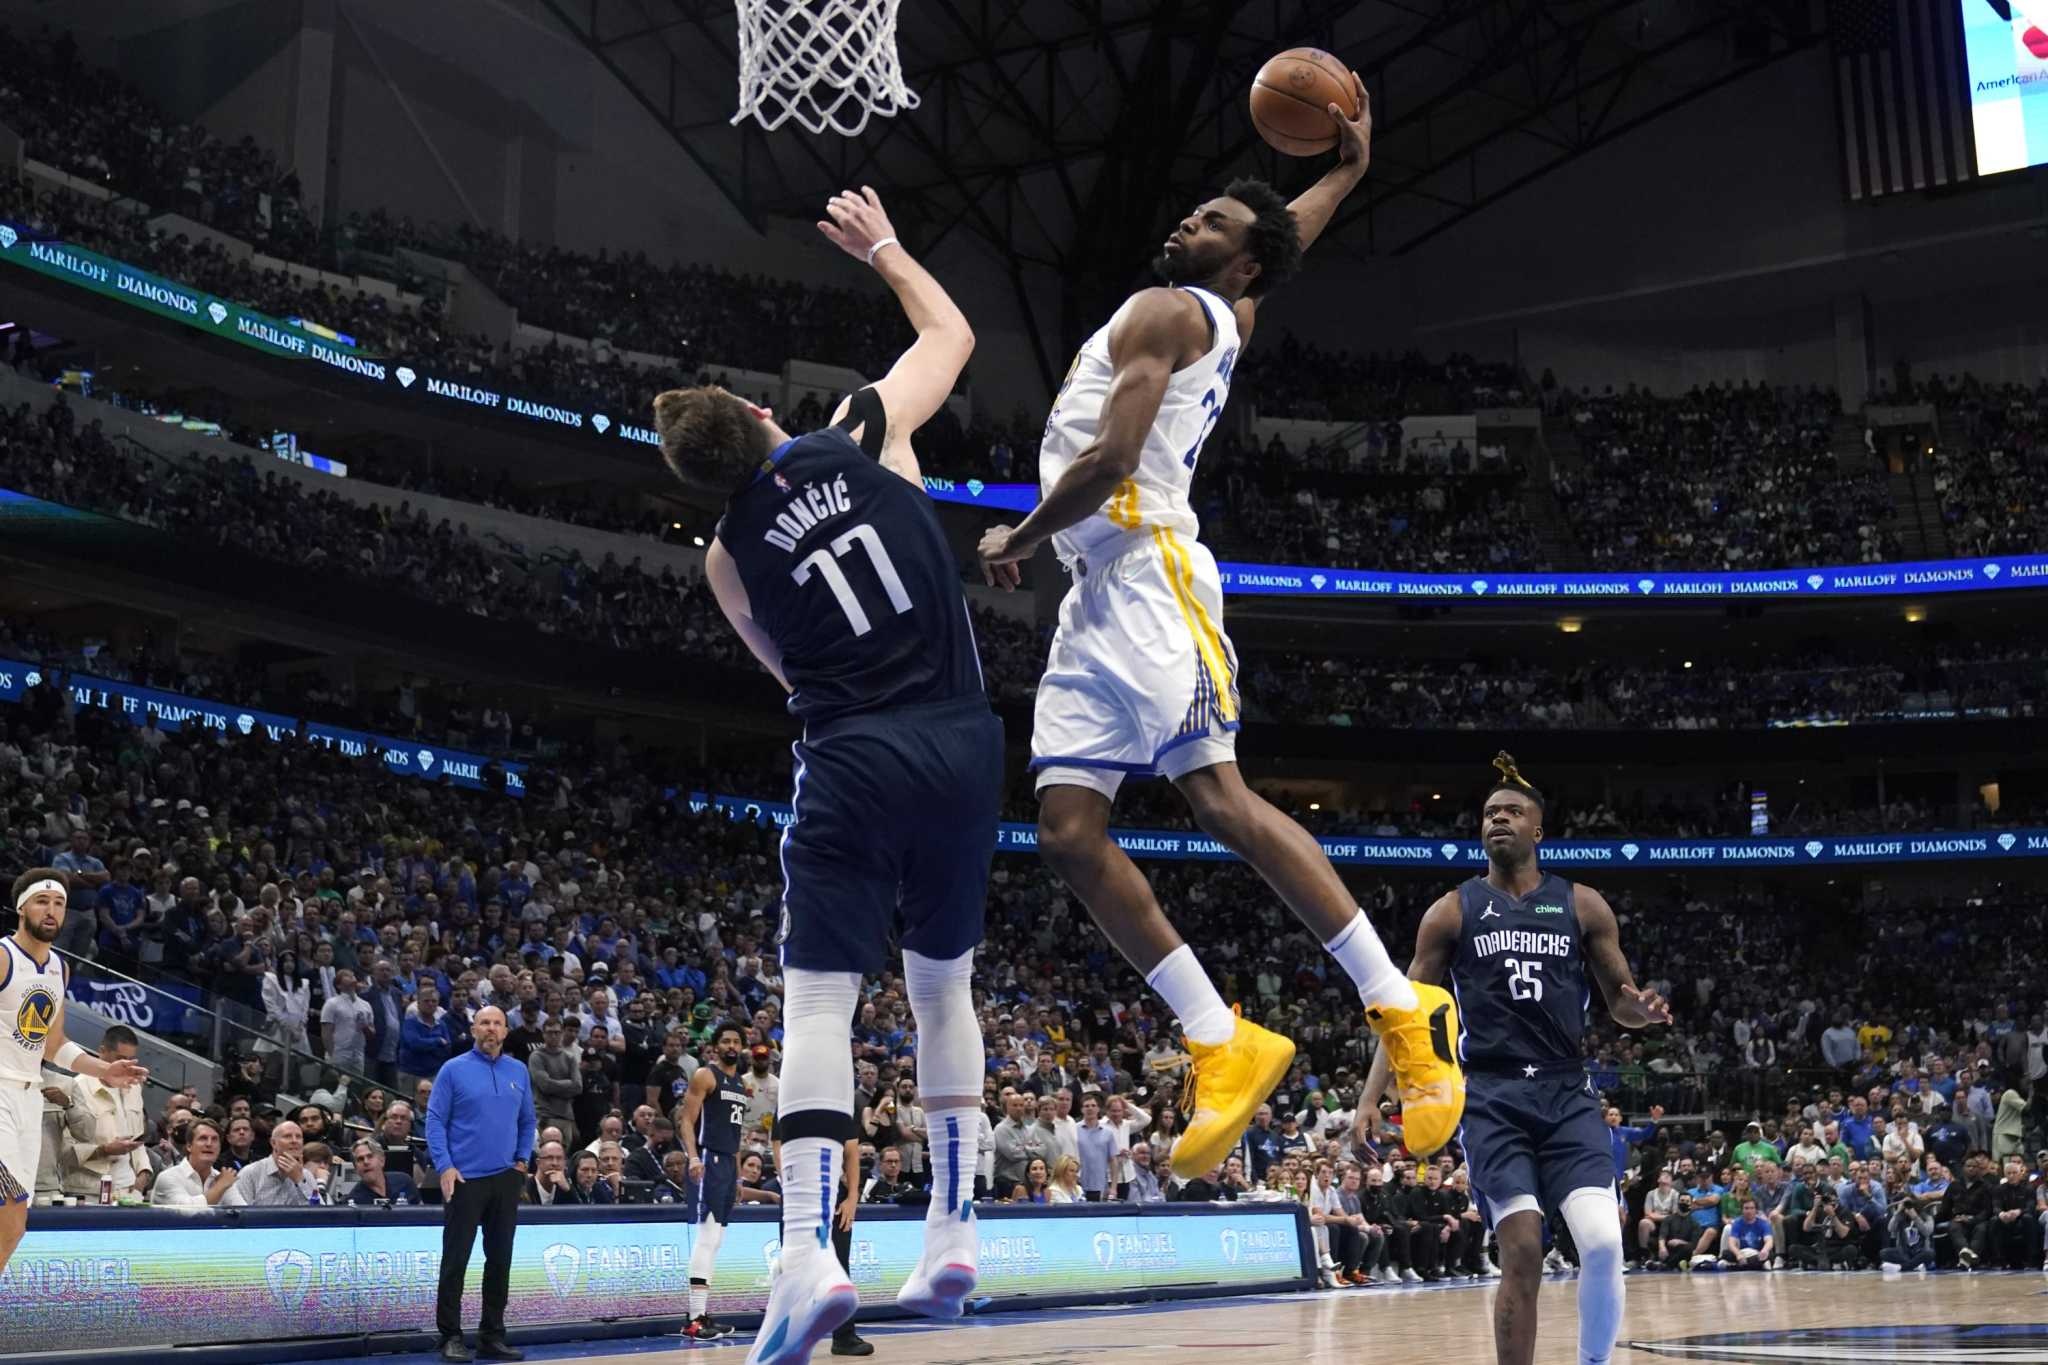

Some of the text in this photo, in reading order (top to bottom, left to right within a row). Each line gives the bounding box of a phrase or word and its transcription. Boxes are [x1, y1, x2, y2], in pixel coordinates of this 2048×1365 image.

[30, 241, 198, 315] MARILOFF DIAMONDS
[238, 317, 385, 380] MARILOFF DIAMONDS
[427, 377, 582, 427] MARILOFF DIAMONDS
[764, 473, 851, 553] DONČIĆ
[791, 523, 913, 637] 77
[1238, 573, 1303, 588] DIAMONDS
[1335, 579, 1463, 595] MARILOFF DIAMONDS
[1664, 580, 1798, 595] MARILOFF DIAMONDS
[1834, 569, 1973, 589] MARILOFF DIAMONDS
[1497, 583, 1630, 595] MARILOFF DIAMONDS
[1118, 837, 1180, 852] MARILOFF
[1364, 846, 1433, 859] DIAMONDS
[1540, 848, 1612, 860] DIAMONDS
[1650, 846, 1795, 859] MARILOFF DIAMONDS
[1834, 839, 1987, 857] MARILOFF DIAMONDS
[1535, 905, 1564, 914] chime
[1474, 930, 1570, 957] MAVERICKS
[1504, 958, 1543, 1002] 25
[730, 1104, 744, 1125] 26
[586, 1244, 688, 1275] FANDUEL
